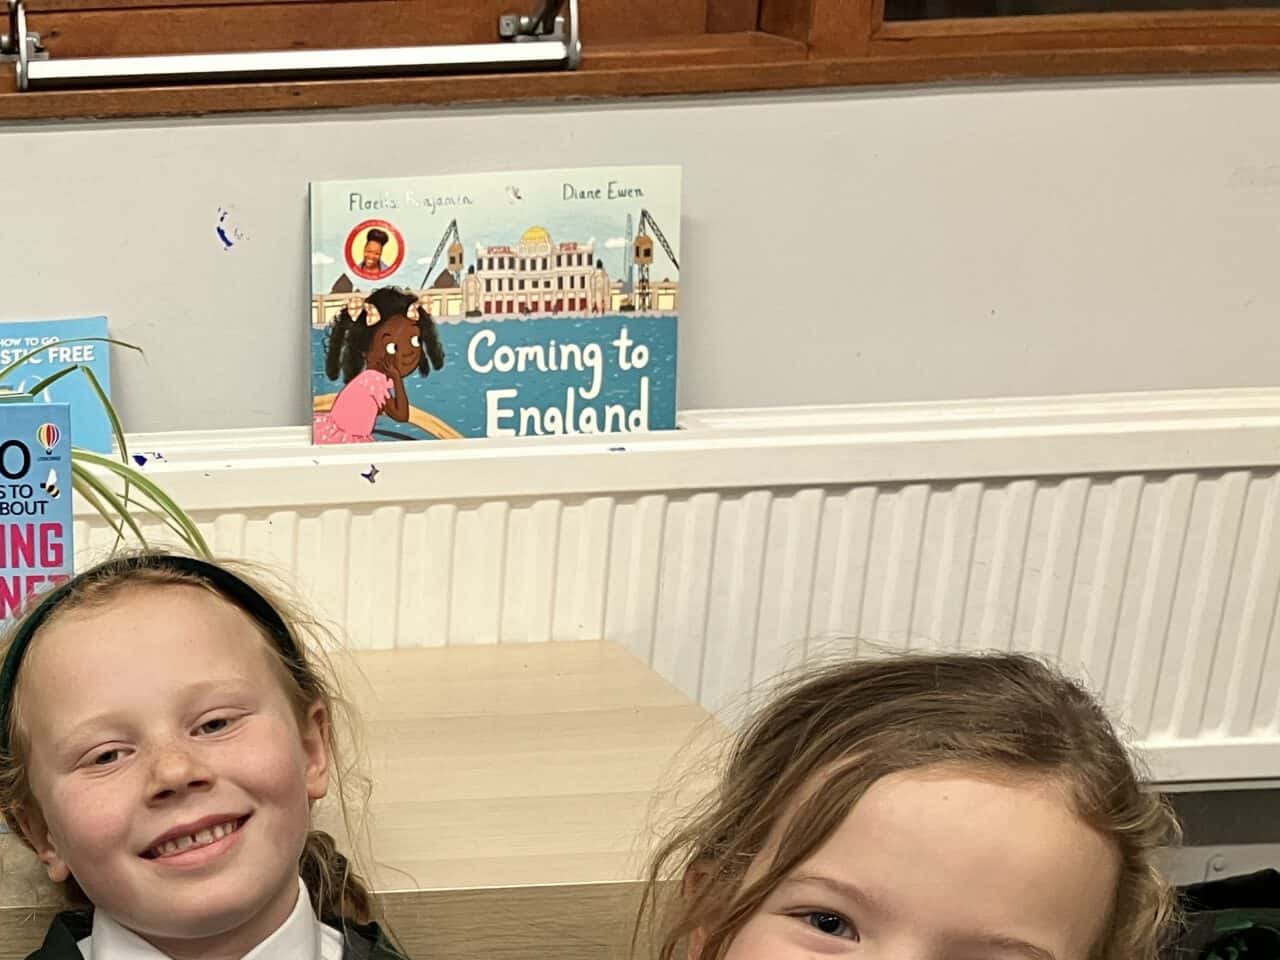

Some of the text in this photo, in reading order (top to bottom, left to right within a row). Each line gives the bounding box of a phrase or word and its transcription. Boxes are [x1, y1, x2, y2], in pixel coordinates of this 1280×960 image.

[562, 180, 644, 201] Diane Ewen
[24, 337, 39, 347] TO
[40, 335, 60, 347] GO
[48, 345, 95, 364] FREE
[466, 327, 650, 400] Coming to
[485, 375, 650, 438] England
[8, 484, 34, 499] TO
